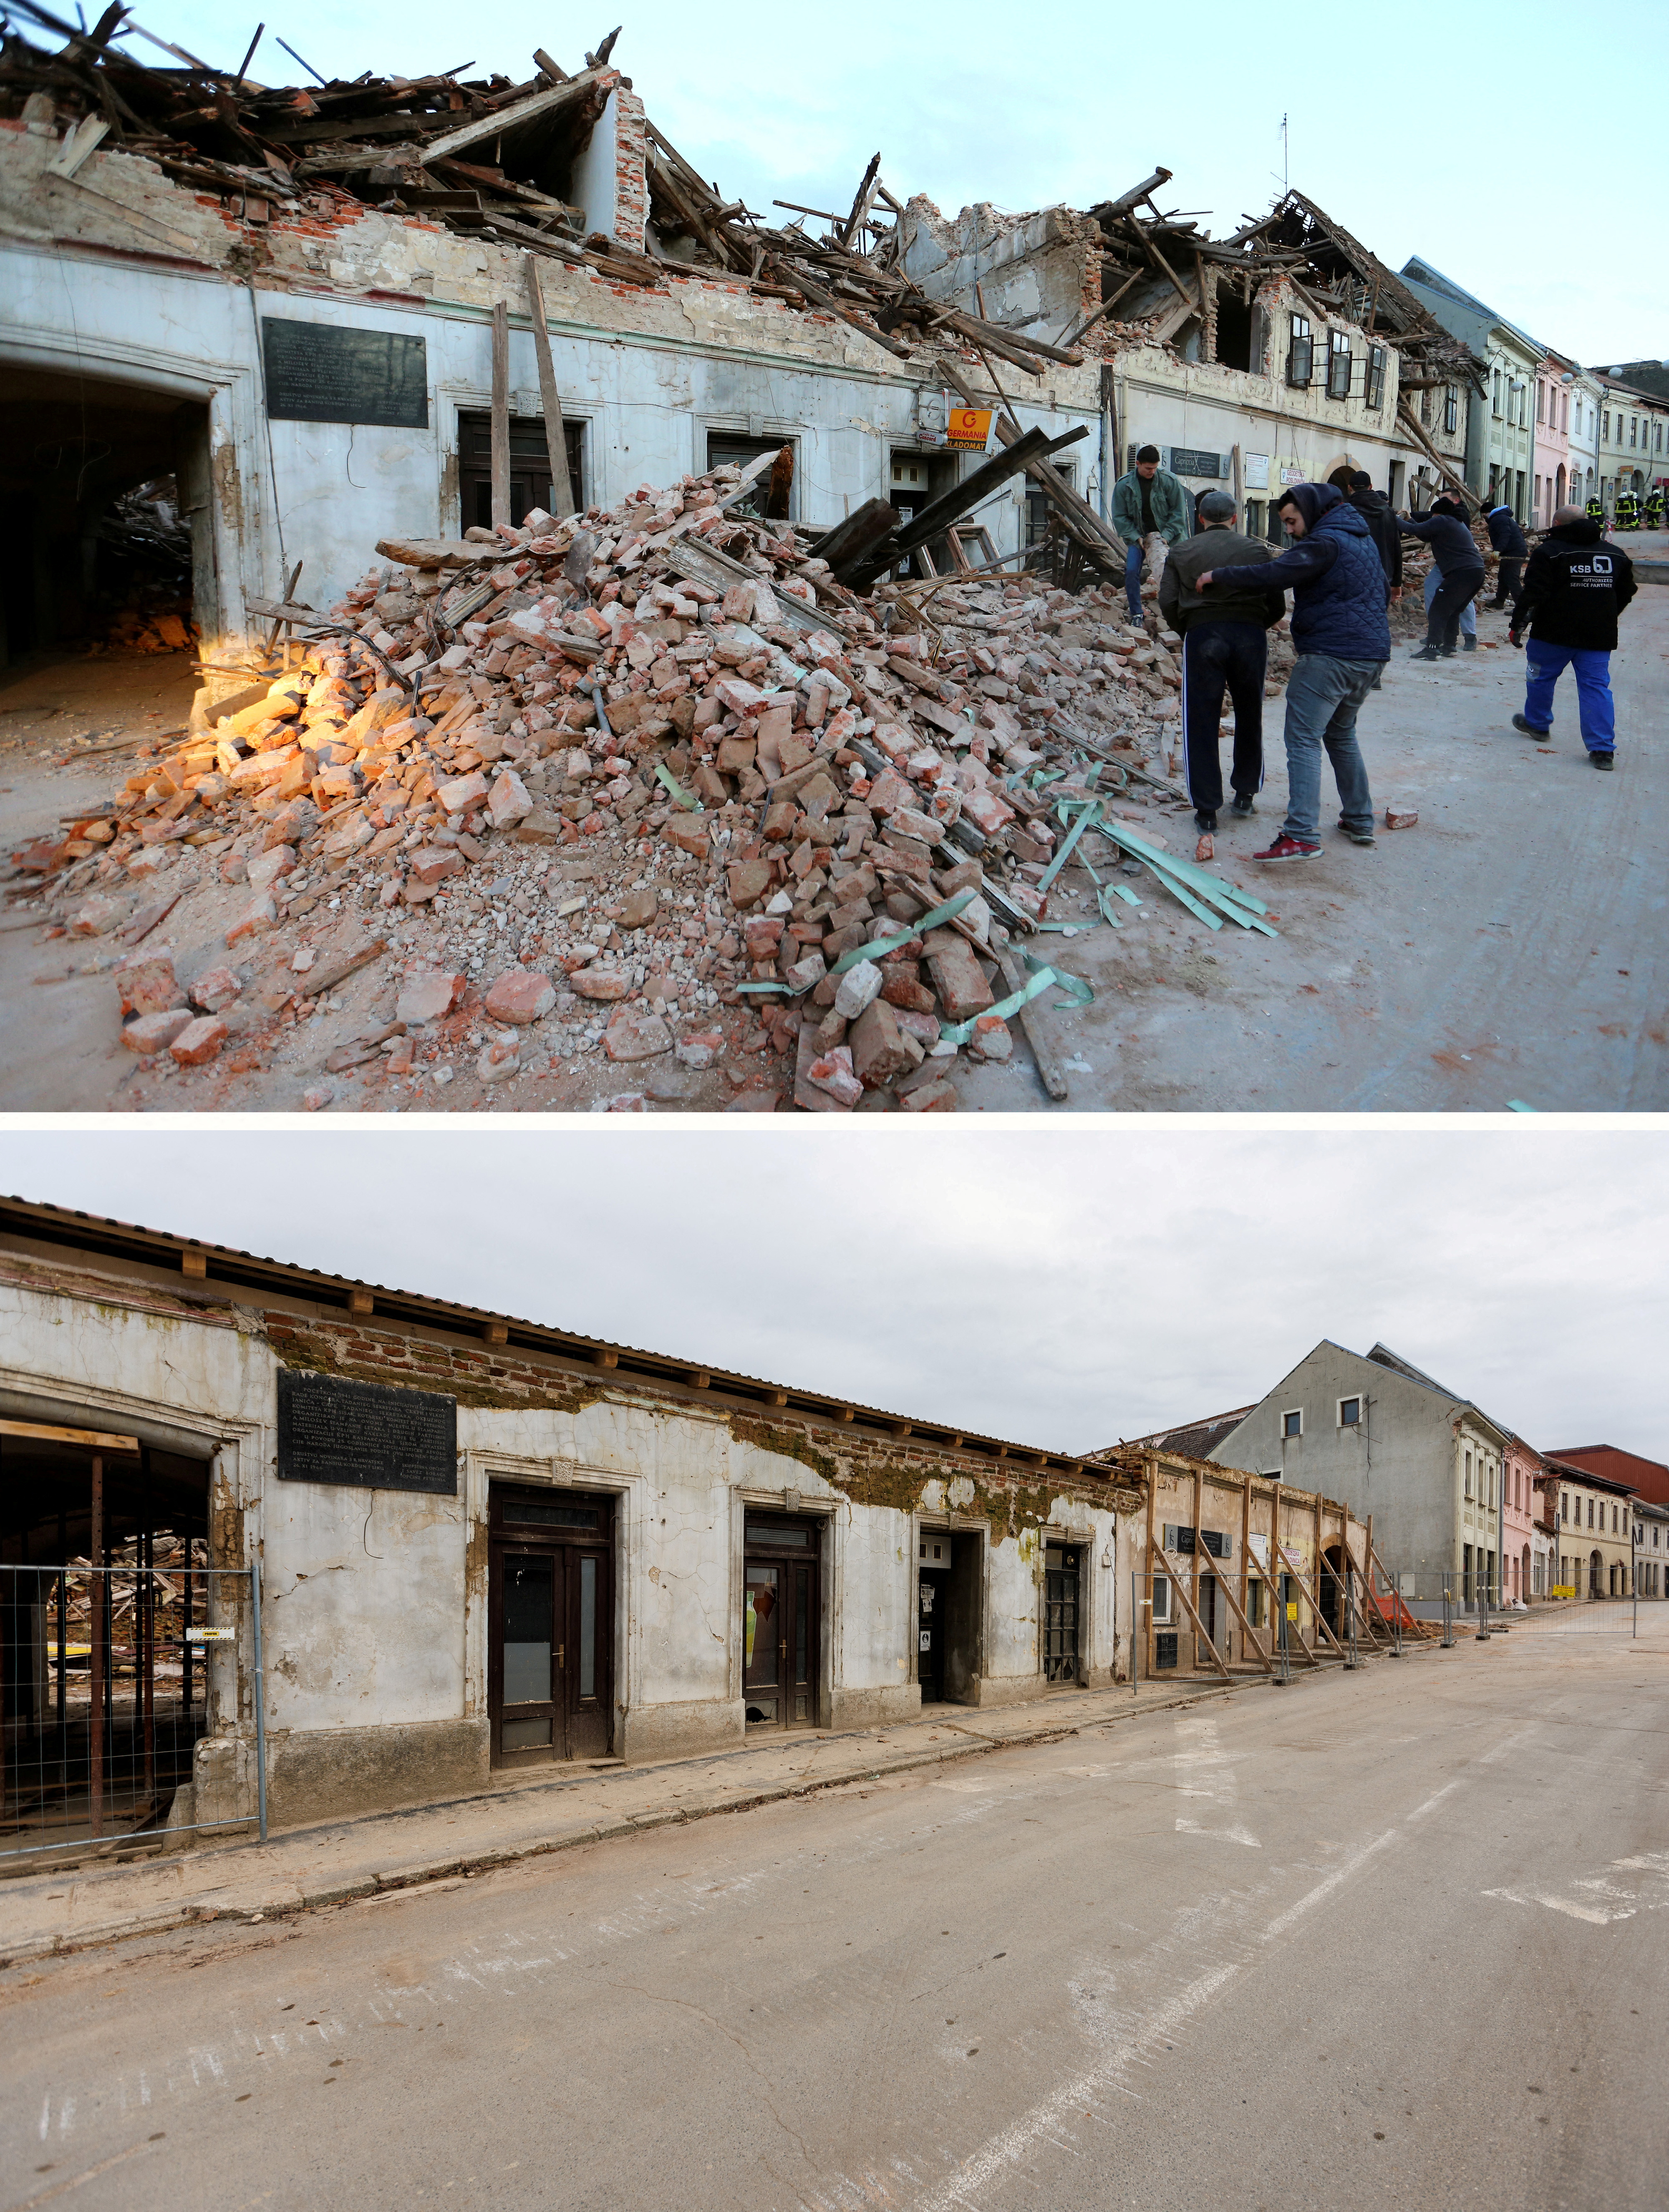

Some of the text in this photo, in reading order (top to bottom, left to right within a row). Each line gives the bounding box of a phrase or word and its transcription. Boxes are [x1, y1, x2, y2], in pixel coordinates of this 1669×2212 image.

[947, 429, 986, 439] GERMANIA
[945, 441, 986, 451] KLADOMAT
[1175, 456, 1195, 466] Capriccia
[304, 1388, 336, 1396] POČETKOM
[292, 1410, 335, 1419] ORGANIZIRAO
[379, 1411, 411, 1419] SEKRETARA
[330, 1420, 361, 1428] ŠTAMPANJE
[292, 1427, 334, 1436] ORGANIZACIJE
[353, 1435, 395, 1444] RASPARČAVALE
[1181, 1535, 1195, 1545] Capric
